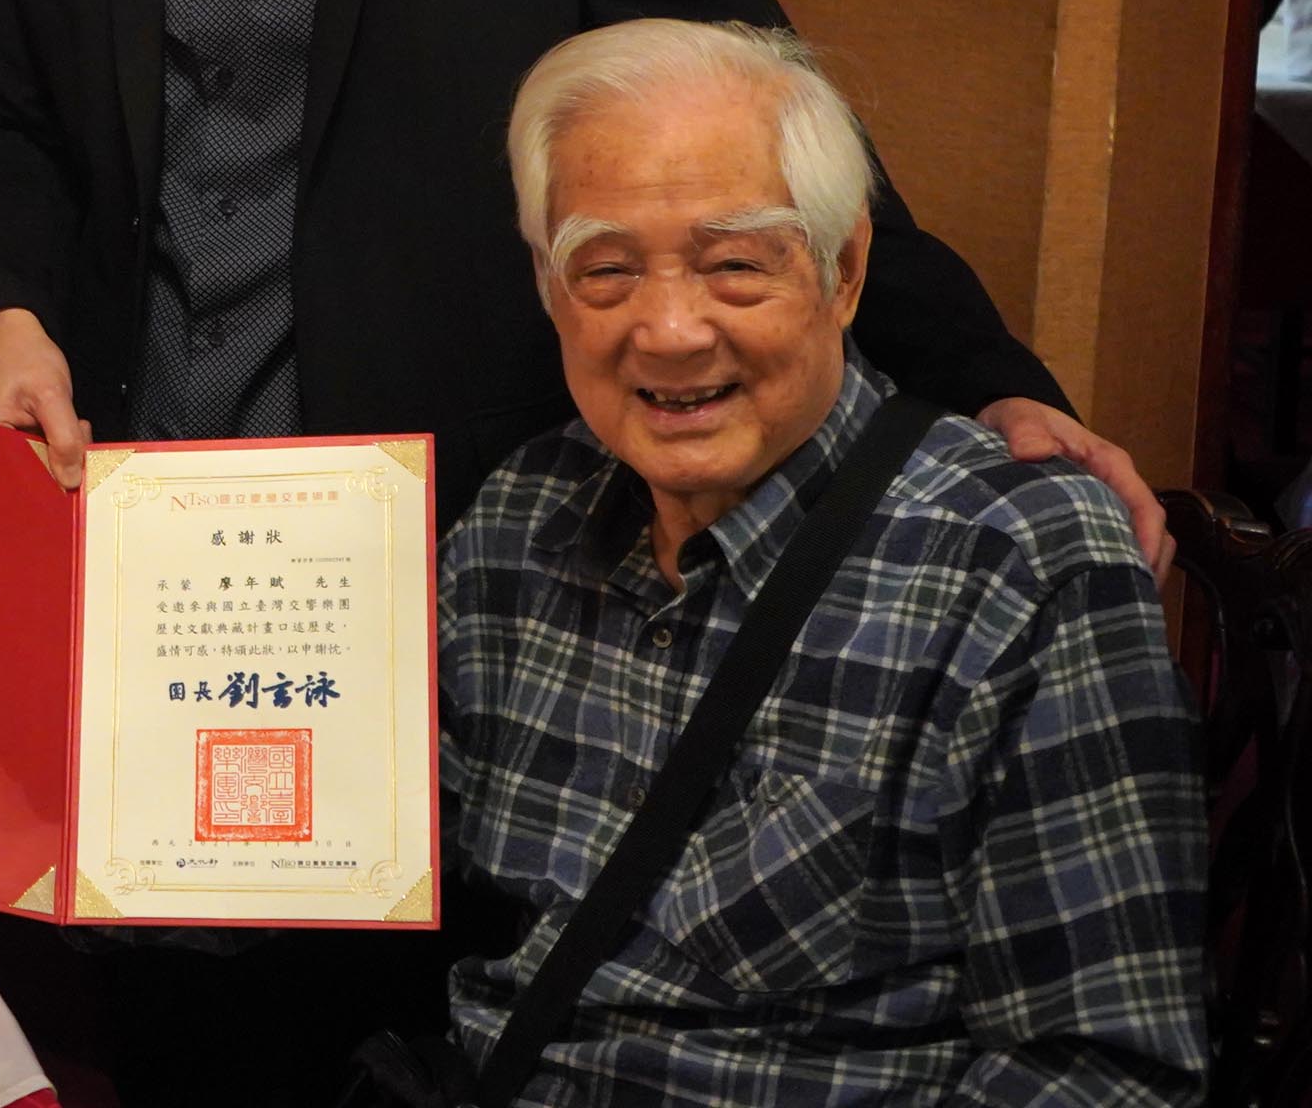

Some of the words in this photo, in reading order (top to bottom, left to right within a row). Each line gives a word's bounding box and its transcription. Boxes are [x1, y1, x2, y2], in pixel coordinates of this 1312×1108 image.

[211, 529, 283, 546] 感謝狀
[157, 578, 193, 592] 承蒙
[217, 575, 285, 591] 廖年賦
[315, 575, 352, 589] 先生
